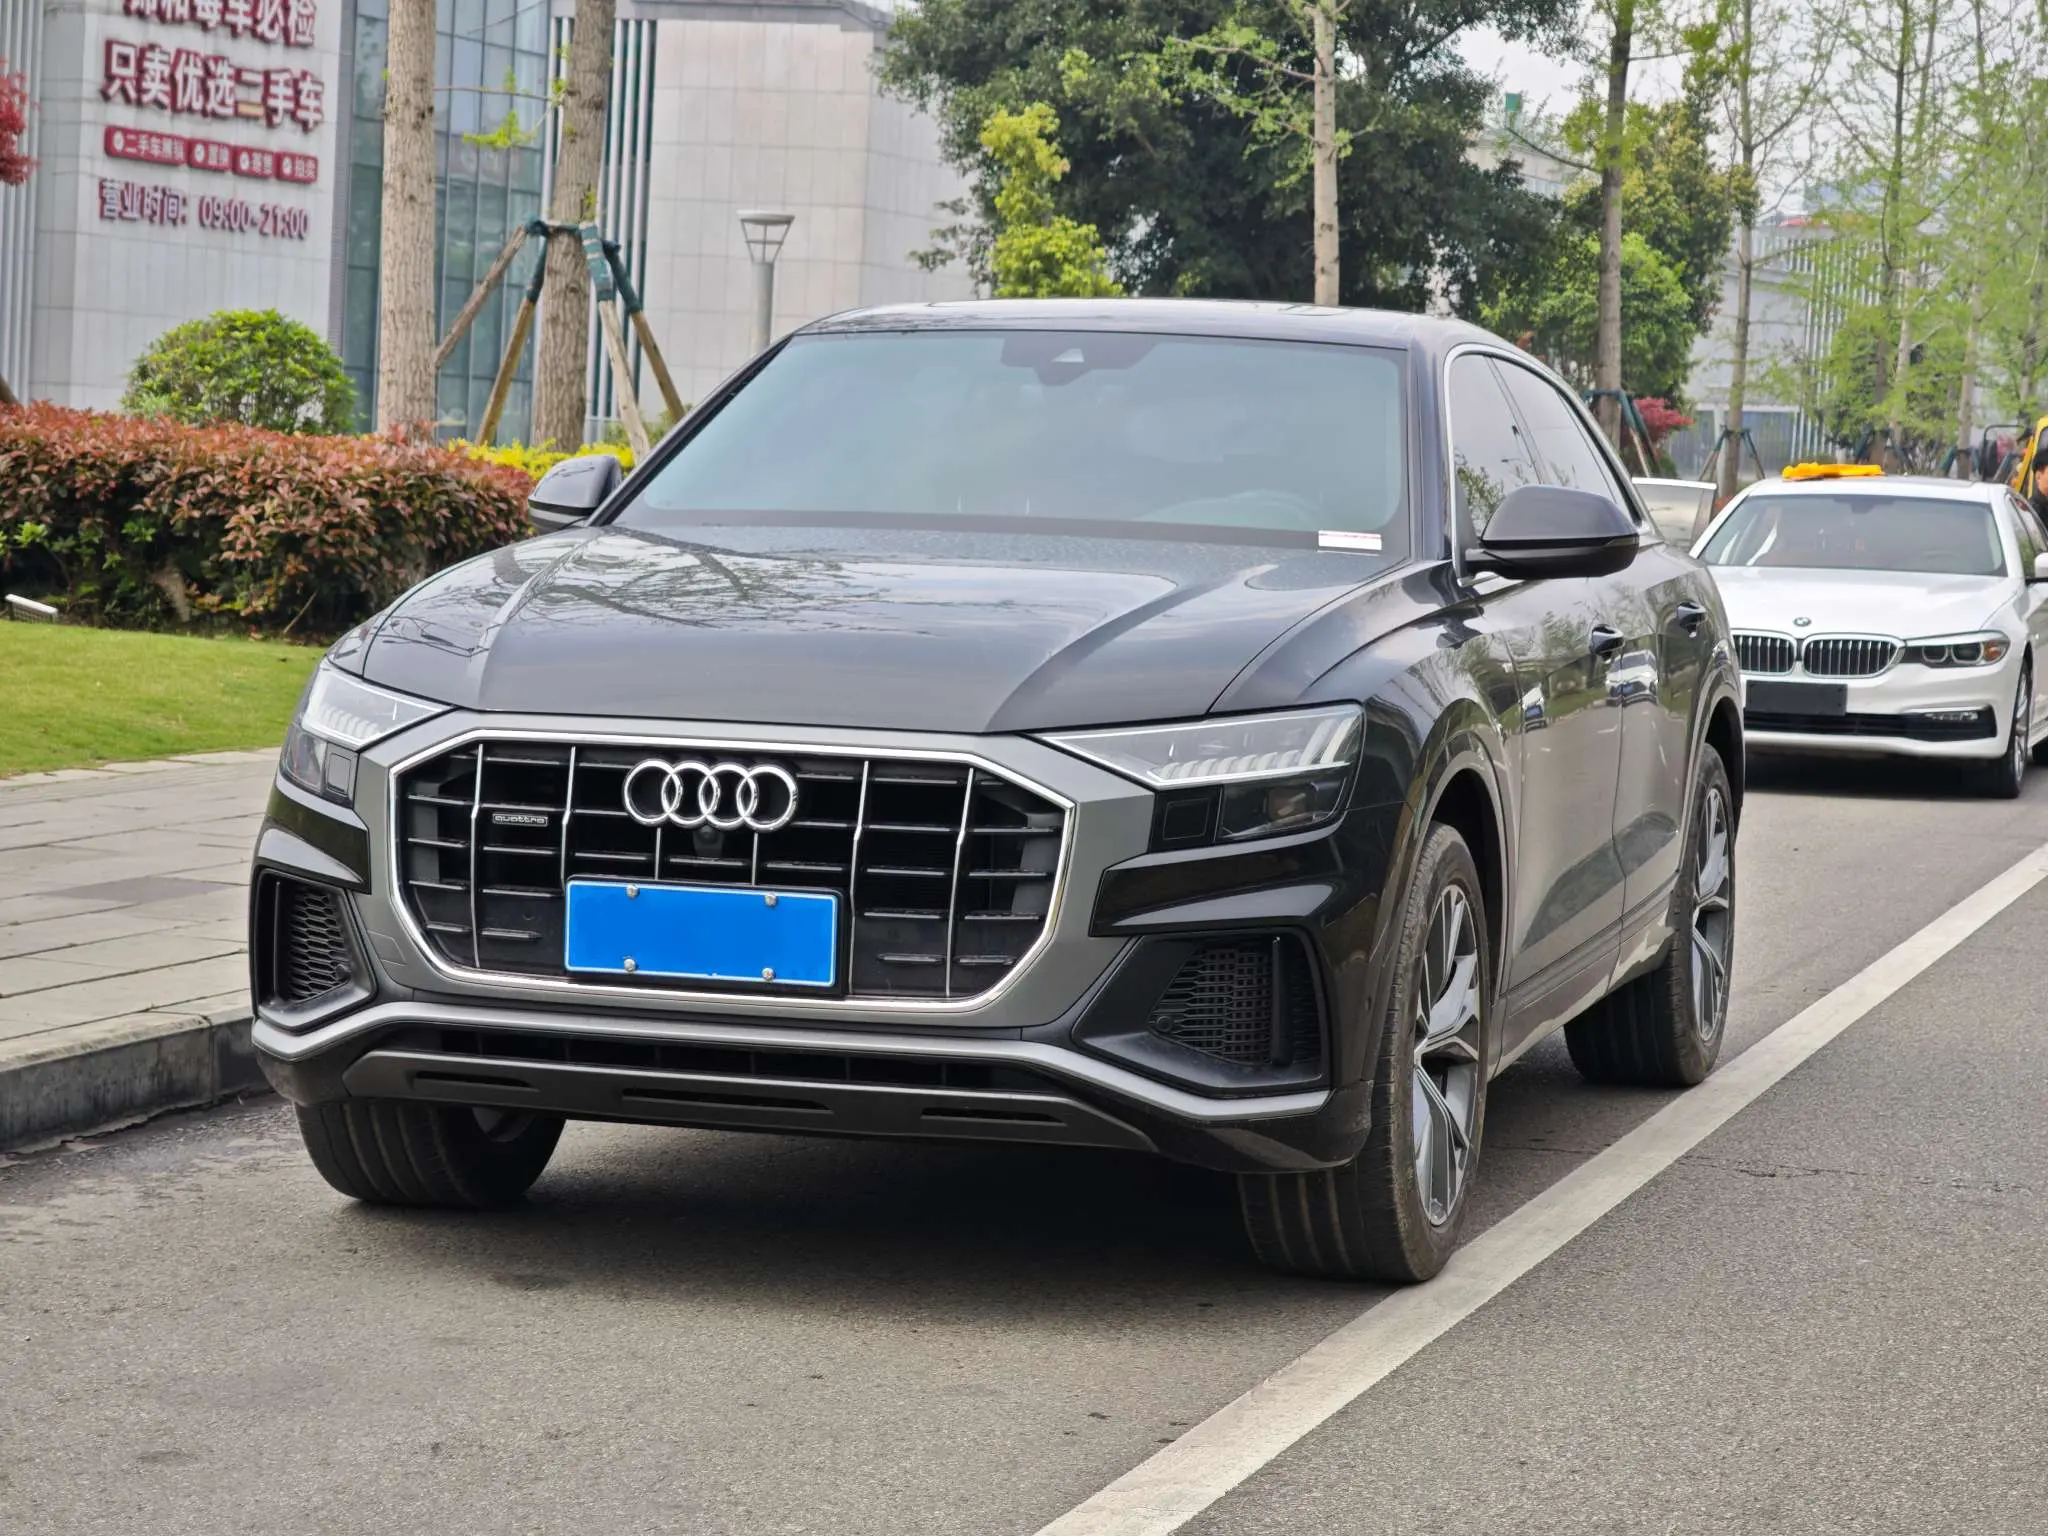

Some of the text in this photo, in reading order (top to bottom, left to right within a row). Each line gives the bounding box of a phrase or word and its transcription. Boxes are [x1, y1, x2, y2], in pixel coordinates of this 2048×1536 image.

[103, 39, 325, 131] 只卖优选二手车
[198, 195, 309, 240] 09:00-21:00
[494, 815, 545, 824] quattro
